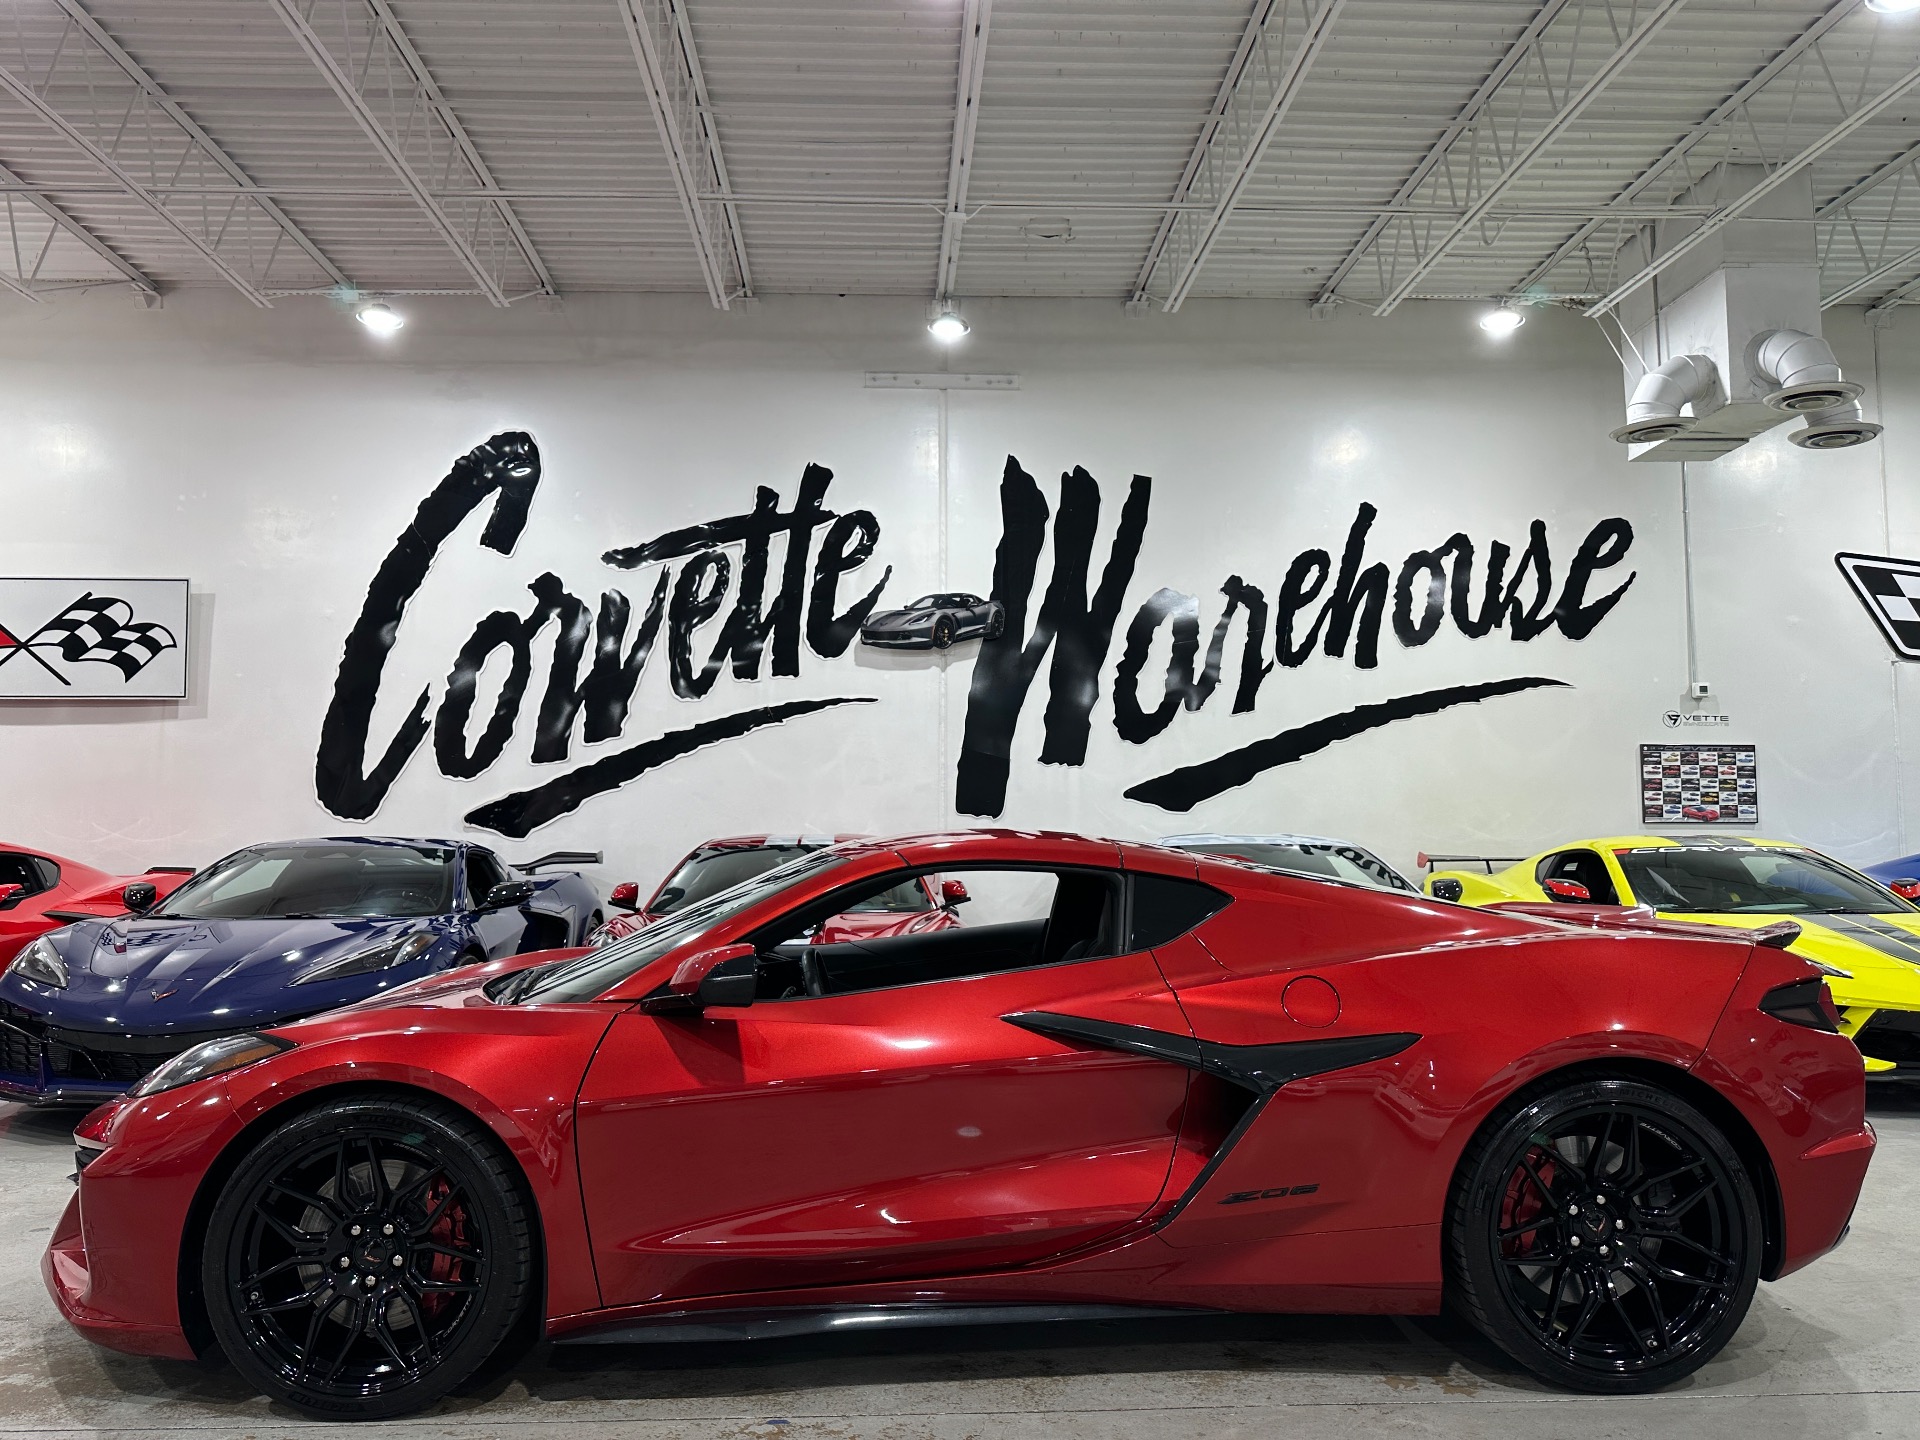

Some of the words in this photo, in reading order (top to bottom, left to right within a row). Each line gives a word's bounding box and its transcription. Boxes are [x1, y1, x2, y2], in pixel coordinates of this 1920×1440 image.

[316, 431, 893, 821] Corvette
[955, 454, 1637, 818] Warehouse
[1682, 714, 1730, 722] VETTE
[1631, 846, 1805, 854] CORVETTE
[1217, 1183, 1321, 1205] Z06
